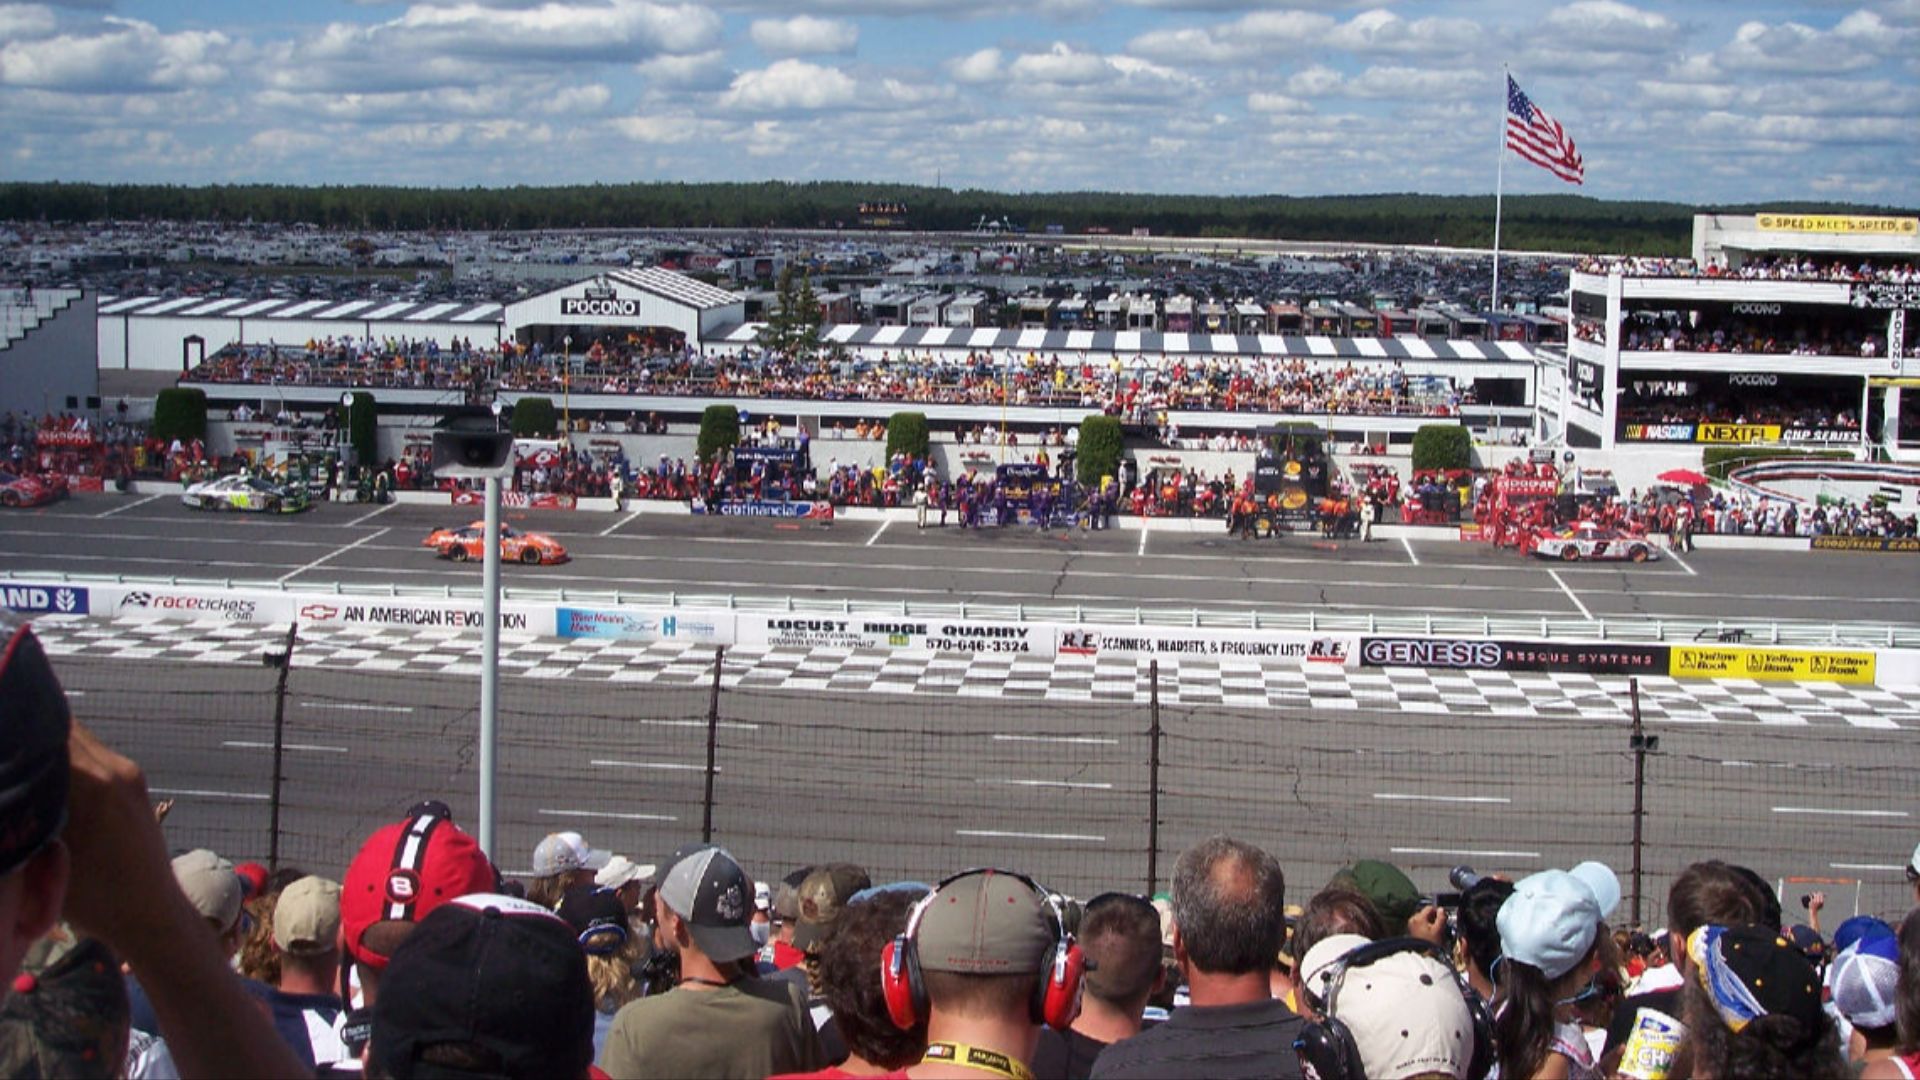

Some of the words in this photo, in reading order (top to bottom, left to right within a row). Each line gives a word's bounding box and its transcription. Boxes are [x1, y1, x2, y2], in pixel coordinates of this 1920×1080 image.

[1776, 218, 1813, 229] SPEED
[1817, 219, 1855, 230] MEETS
[566, 301, 637, 315] POCONO
[1732, 302, 1781, 314] POCONO
[1729, 375, 1777, 387] POCONO
[1647, 425, 1691, 440] NASCAR
[1704, 424, 1772, 441] NEXTEL
[1813, 427, 1860, 441] SERIES
[154, 596, 255, 612] racetickets
[344, 607, 365, 621] AN
[368, 607, 441, 625] AMERICAN
[445, 610, 526, 629] REVOION
[767, 620, 848, 631] LOCUST
[864, 623, 927, 635] RIDGE
[942, 624, 1029, 638] QUARRY
[926, 638, 1029, 652] 570-646-3324
[1102, 638, 1155, 654] SCANNERS,
[1157, 639, 1209, 655] HEADSETS,
[1221, 640, 1279, 656] FREQUENCY
[1281, 643, 1306, 657] LISTS
[1364, 641, 1502, 668] GENESIS
[1506, 651, 1569, 664] RESCUE
[1578, 653, 1652, 666] SYSTEMS
[1698, 652, 1738, 662] Yellow
[1766, 654, 1804, 663] Yellow
[1830, 656, 1869, 666] Yellow
[1697, 661, 1727, 671] Book
[1764, 664, 1794, 673] Book
[1828, 666, 1858, 675] Book
